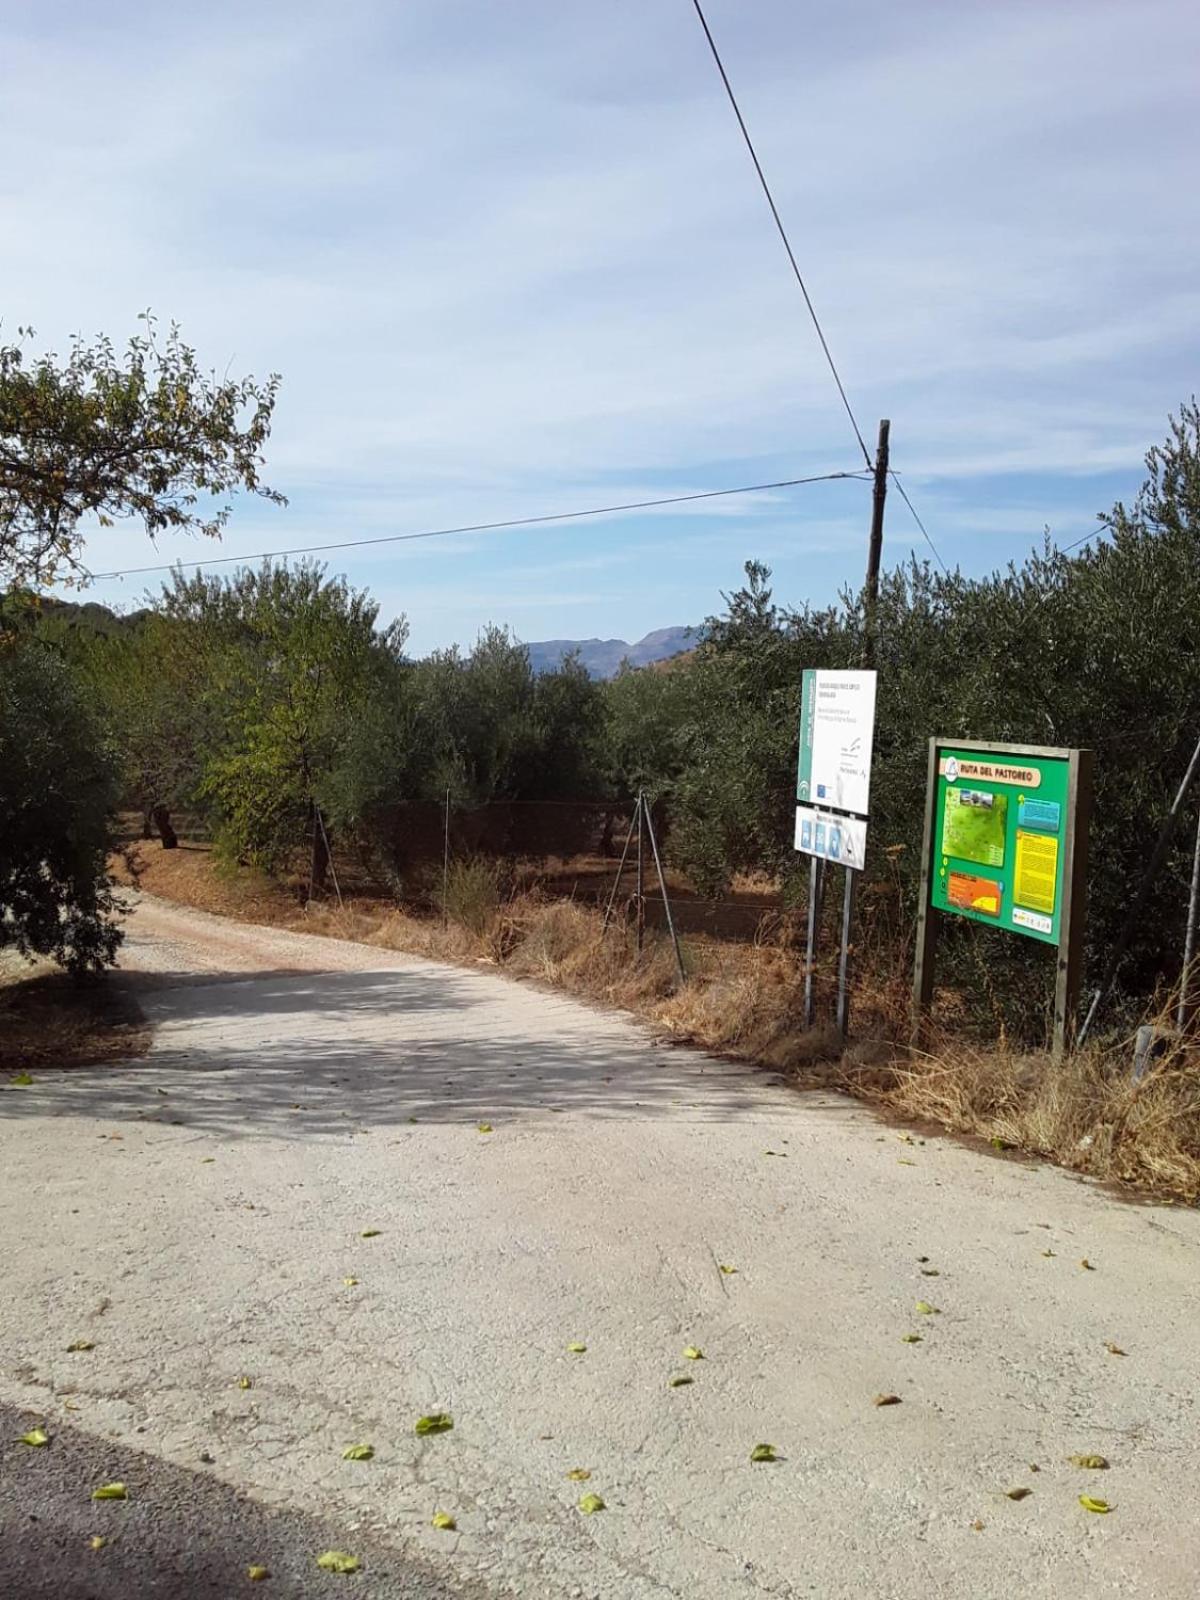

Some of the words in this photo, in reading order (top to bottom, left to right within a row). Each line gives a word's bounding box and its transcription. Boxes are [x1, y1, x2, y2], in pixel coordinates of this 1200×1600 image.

[961, 764, 978, 774] RUTA
[980, 766, 993, 777] DEL
[995, 768, 1033, 782] PASTOREO
